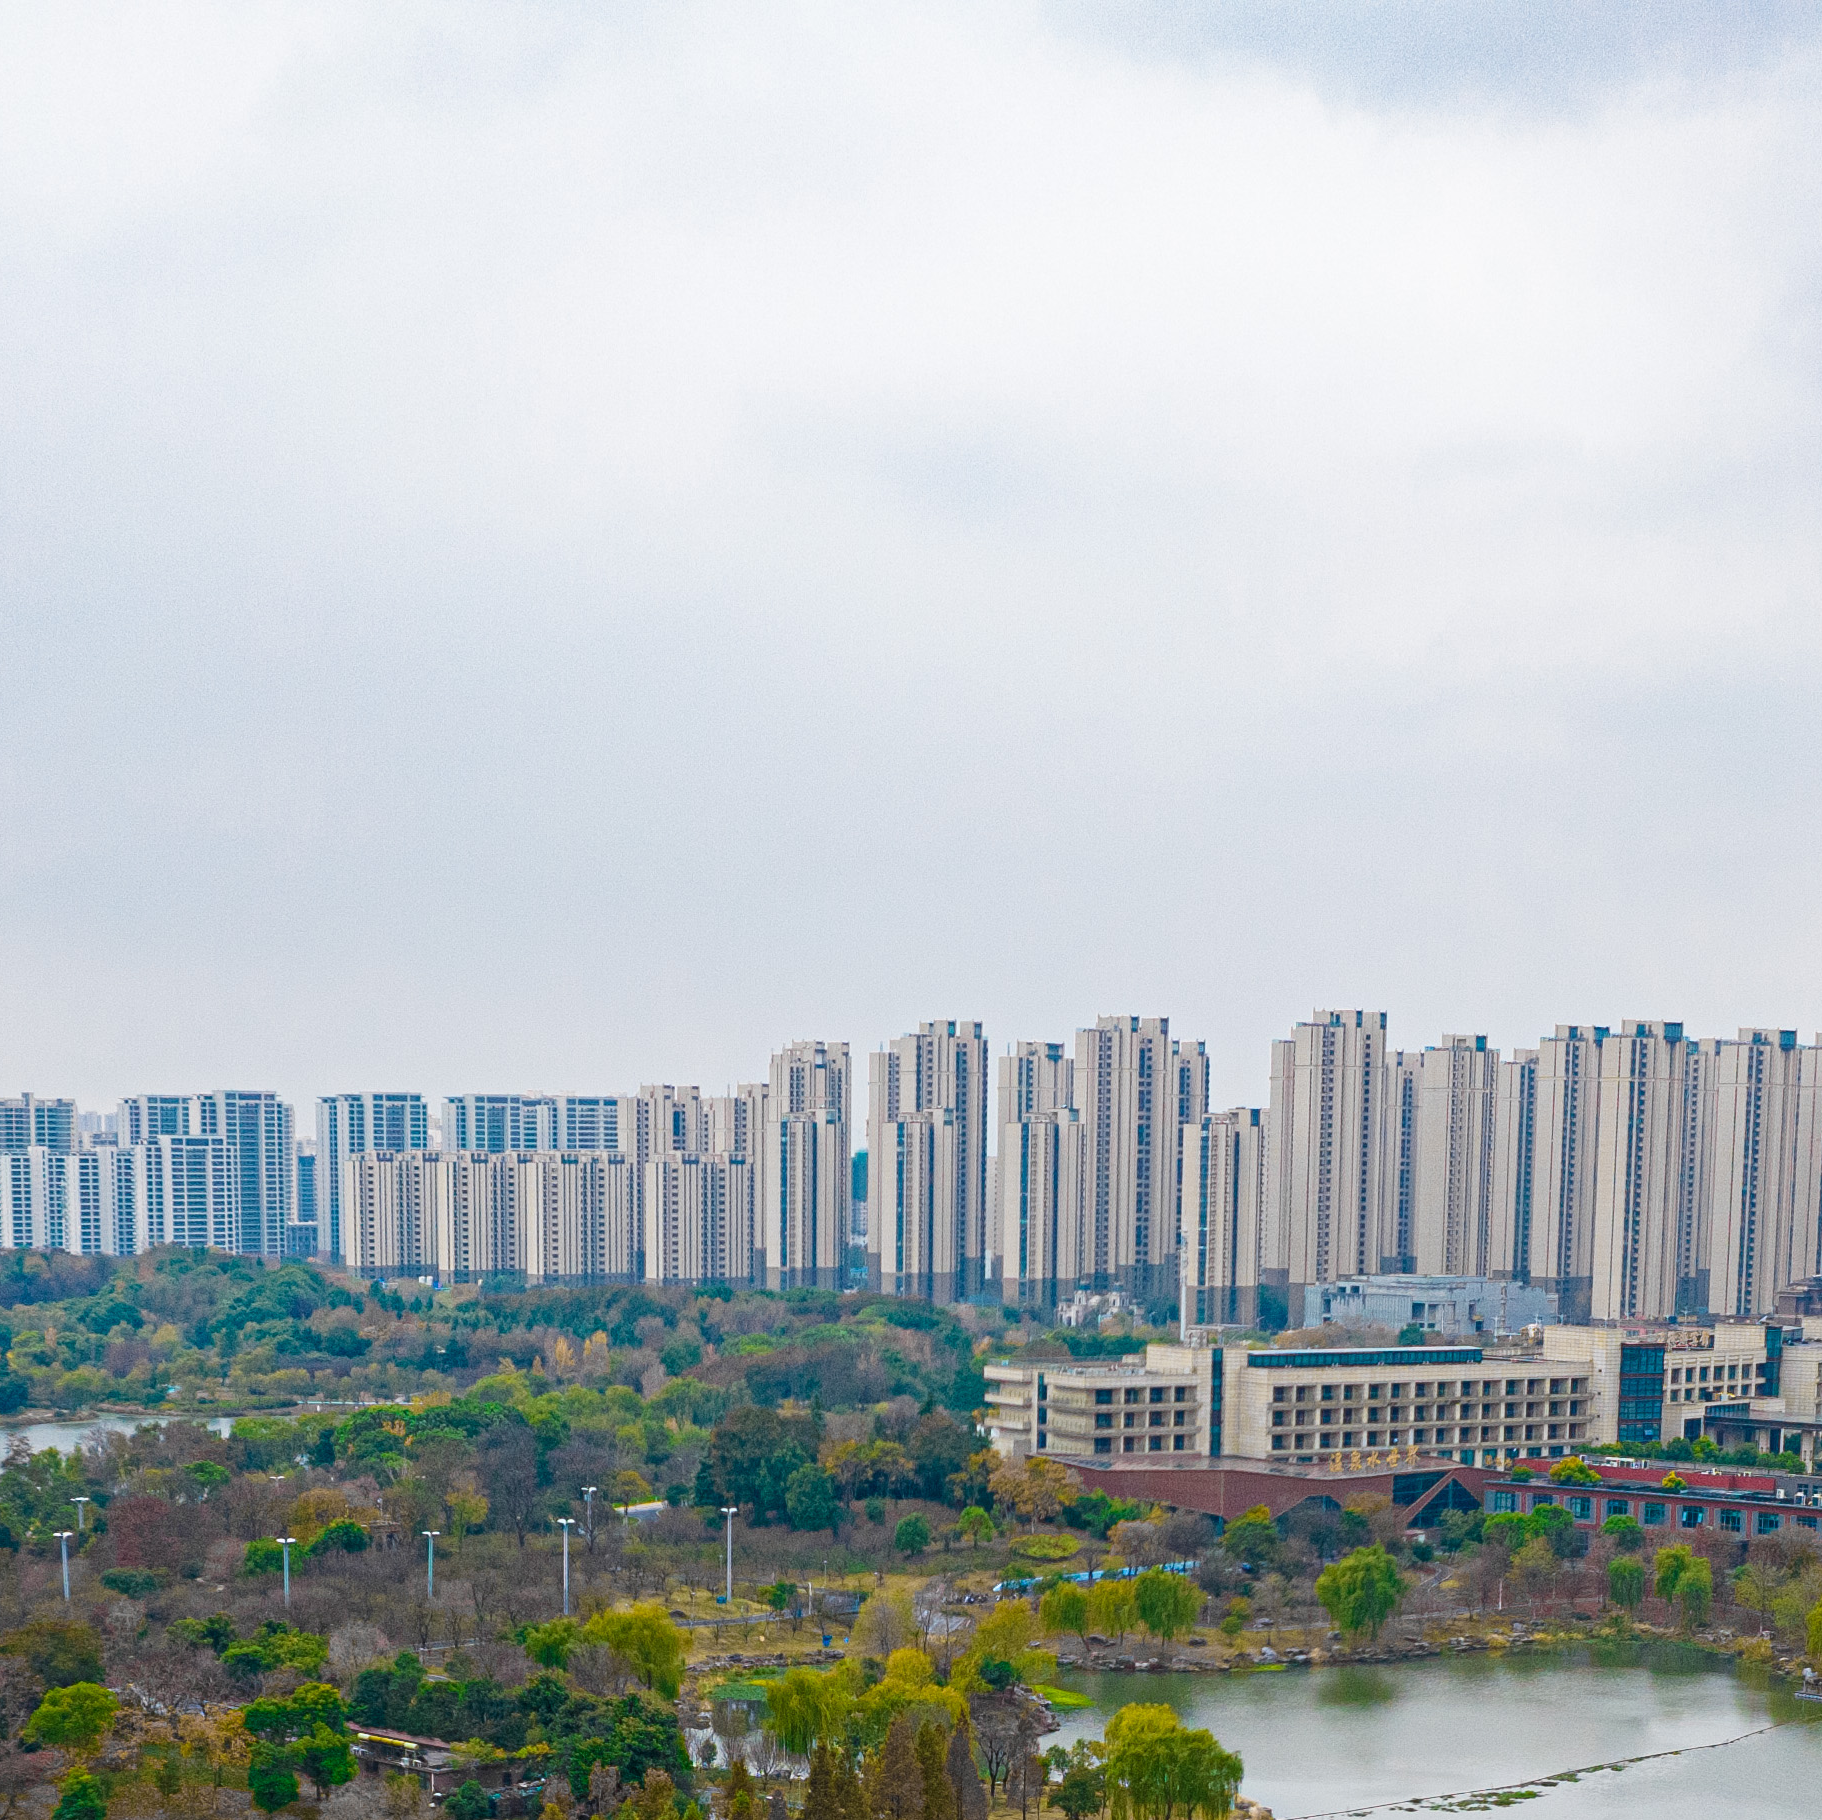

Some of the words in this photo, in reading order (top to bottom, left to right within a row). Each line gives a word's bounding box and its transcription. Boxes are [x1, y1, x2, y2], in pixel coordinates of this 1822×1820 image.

[1330, 1444, 1420, 1473] 温泉水世界
